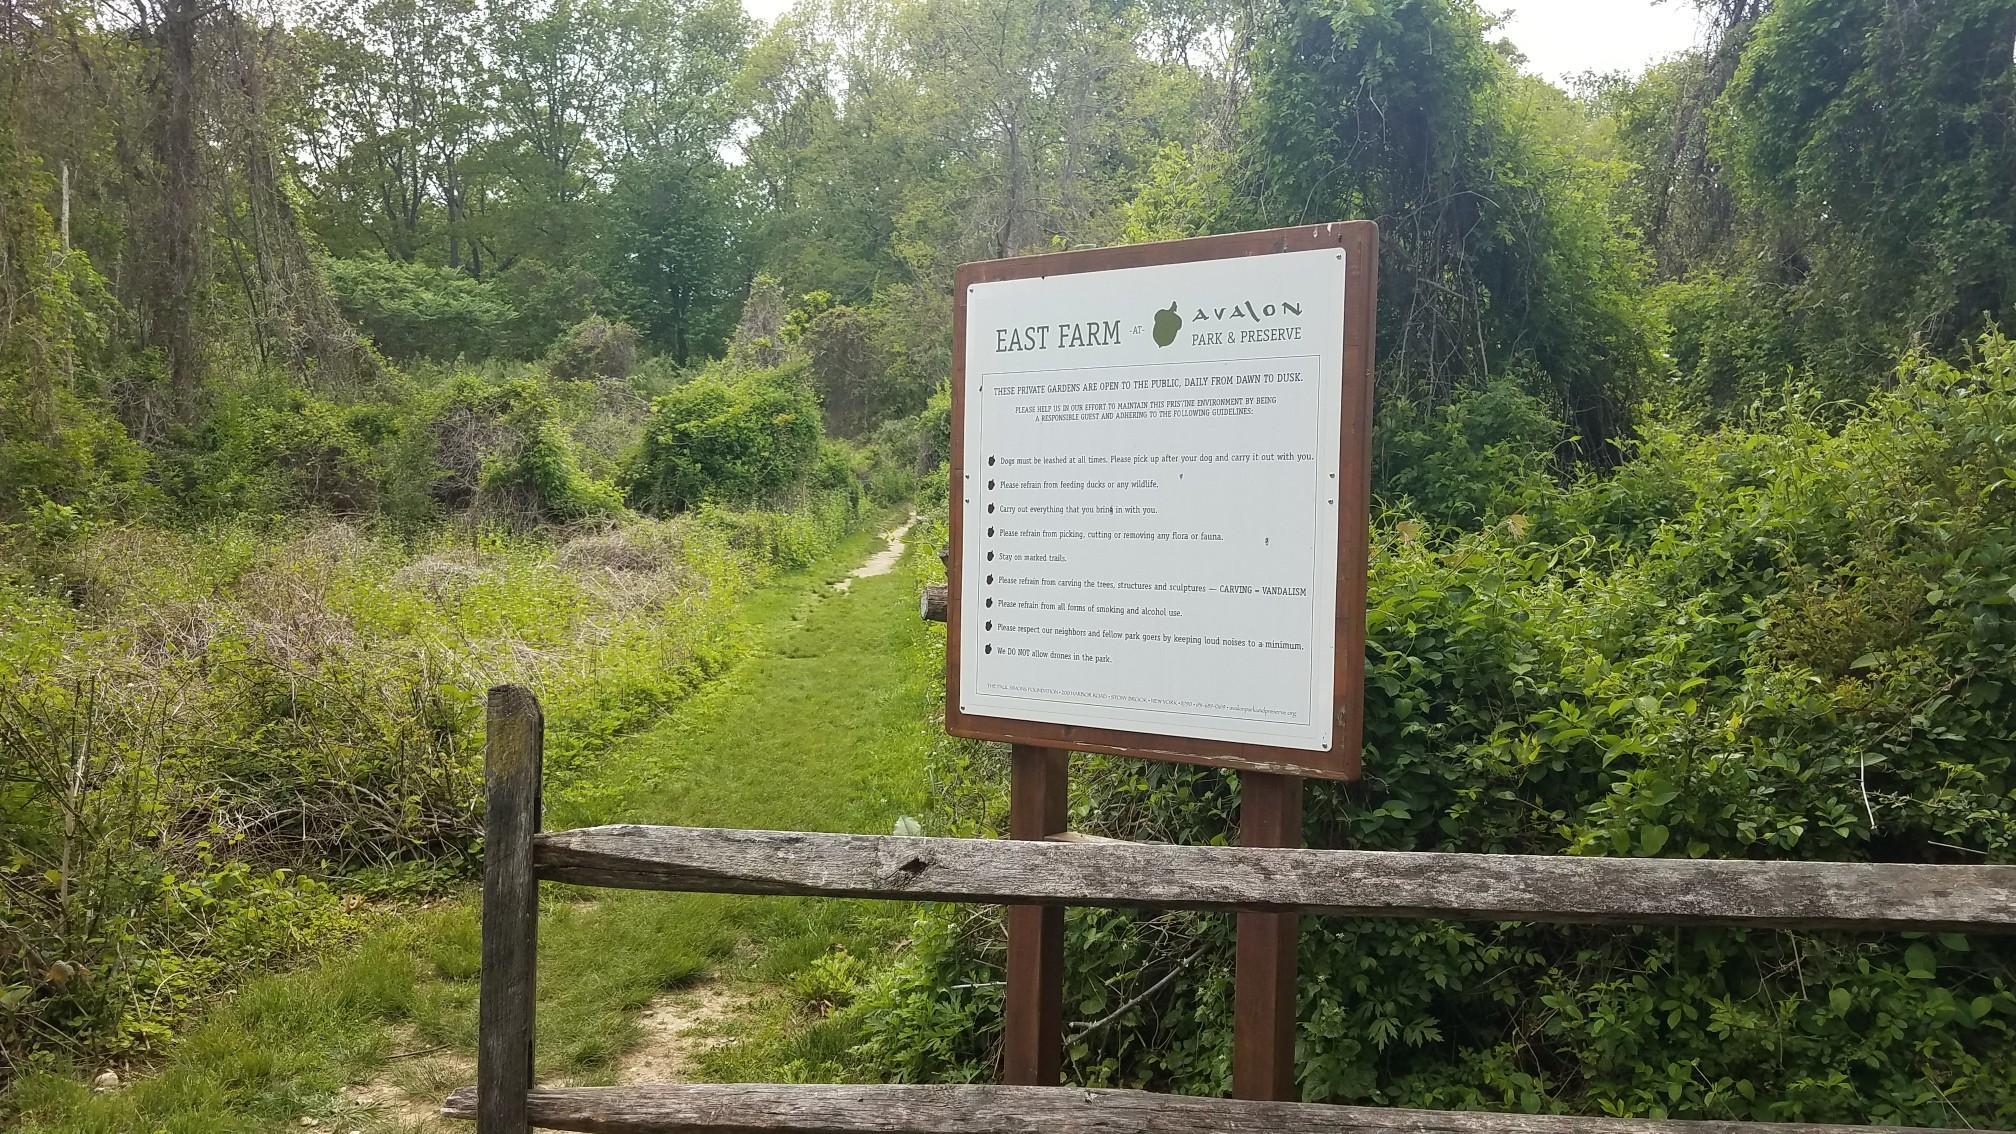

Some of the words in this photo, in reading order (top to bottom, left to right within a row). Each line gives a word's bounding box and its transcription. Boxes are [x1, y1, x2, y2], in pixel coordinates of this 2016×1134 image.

[995, 325, 1049, 352] EAST
[1057, 319, 1120, 348] FARM
[1192, 331, 1222, 346] PARK
[1227, 331, 1235, 344] &
[1240, 326, 1301, 343] PRESERVE
[993, 386, 1015, 396] THESE
[1017, 385, 1045, 395] PRIVATE
[1047, 383, 1080, 393] GARDENS
[1082, 382, 1097, 391] ARE
[1099, 381, 1118, 391] OPEN
[1121, 380, 1130, 390] TO
[1133, 379, 1148, 389] THE
[1151, 378, 1181, 388] PUBLIC,
[1184, 376, 1208, 387] DAILY
[1211, 375, 1233, 386] FROM
[1236, 374, 1260, 384] DAWN
[1263, 373, 1273, 383] TO
[1277, 372, 1303, 383] DUSK.
[1015, 405, 1035, 414] PLEASE
[1036, 405, 1051, 414] HELP
[1053, 404, 1060, 413] US
[1062, 404, 1069, 412] IN
[1070, 404, 1082, 412] OUR
[1084, 402, 1106, 411] EFFORT
[1108, 402, 1115, 410] TO
[1117, 401, 1148, 410] MAINTAIN
[1149, 400, 1164, 409] THIS
[1196, 397, 1243, 407] ENVIRONMENT
[1245, 397, 1253, 405] BY
[1256, 396, 1276, 404] BEING
[1041, 413, 1078, 422] RESPONSIBLE
[1080, 412, 1099, 420] GUEST
[1115, 411, 1147, 419] ADHERING
[1158, 410, 1171, 418] THE
[1173, 408, 1209, 417] FOLLOWING
[1211, 407, 1253, 416] GUIDELINES:
[1000, 456, 1014, 466] Dogs
[1033, 456, 1041, 464] be
[1043, 455, 1066, 464] leashed
[1088, 455, 1107, 464] times.
[1110, 454, 1131, 463] Please
[1133, 454, 1147, 464] pick
[1150, 456, 1159, 464] up
[1161, 454, 1177, 462] after
[1180, 455, 1196, 463] your
[1199, 453, 1212, 464] dog
[1215, 453, 1228, 461] and
[1231, 454, 1250, 463] carry
[1252, 452, 1258, 461] it
[1276, 451, 1294, 460] with
[1297, 452, 1314, 463] you.
[1000, 480, 1018, 488] Please
[1020, 480, 1041, 488] refrain
[1043, 480, 1058, 488] from
[1060, 480, 1084, 490] feeding
[1086, 480, 1105, 488] ducks
[1116, 482, 1128, 490] any
[1131, 479, 1158, 488] wildlife.
[999, 504, 1015, 515] Carry
[1029, 504, 1063, 515] everything
[1066, 504, 1078, 513] that
[1081, 506, 1093, 515] you
[1115, 505, 1122, 514] in
[1124, 505, 1140, 514] with
[1142, 507, 1157, 515] you.
[999, 528, 1018, 537] Please
[1020, 529, 1040, 537] refrain
[1042, 529, 1057, 538] from
[1059, 529, 1085, 540] picking,
[1087, 530, 1111, 540] cutting
[1123, 530, 1154, 541] removing
[1156, 533, 1169, 541] any
[1172, 531, 1188, 540] flora
[1200, 531, 1223, 540] fauna.
[999, 552, 1012, 562] Stay
[1024, 553, 1046, 562] marked
[1049, 554, 1066, 562] trails.
[998, 575, 1016, 584] Please
[1018, 576, 1039, 585] refrain
[1041, 577, 1055, 586] from
[1057, 578, 1081, 588] carving
[1083, 579, 1094, 588] the
[1096, 580, 1114, 589] trees,
[1117, 582, 1151, 590] structures
[1154, 582, 1166, 590] and
[1169, 583, 1205, 593] sculptures
[1219, 584, 1252, 594] CARVING
[1262, 586, 1306, 596] VANDALISM
[998, 599, 1016, 608] Please
[1018, 600, 1038, 609] refrain
[1040, 601, 1055, 610] from
[1067, 602, 1085, 612] forms
[1087, 603, 1094, 612] of
[1096, 604, 1124, 616] smoking
[1126, 606, 1138, 614] and
[1141, 607, 1166, 616] alcohol
[997, 623, 1015, 632] Please
[1017, 626, 1039, 634] respect
[1054, 627, 1086, 636] neighbors
[1102, 629, 1122, 638] fellow
[1124, 631, 1140, 640] park
[1162, 633, 1171, 644] by
[1173, 634, 1201, 646] keeping
[1204, 636, 1219, 645] loud
[1222, 637, 1245, 647] noises
[1248, 639, 1255, 647] to
[1265, 639, 1303, 650] minimum.
[997, 646, 1005, 655] We
[1007, 647, 1015, 656] DO
[1017, 648, 1030, 656] NOT
[1031, 649, 1048, 658] allow
[1049, 650, 1071, 660] drones
[1073, 652, 1079, 660] in
[1081, 653, 1093, 661] the
[1095, 654, 1111, 664] park.
